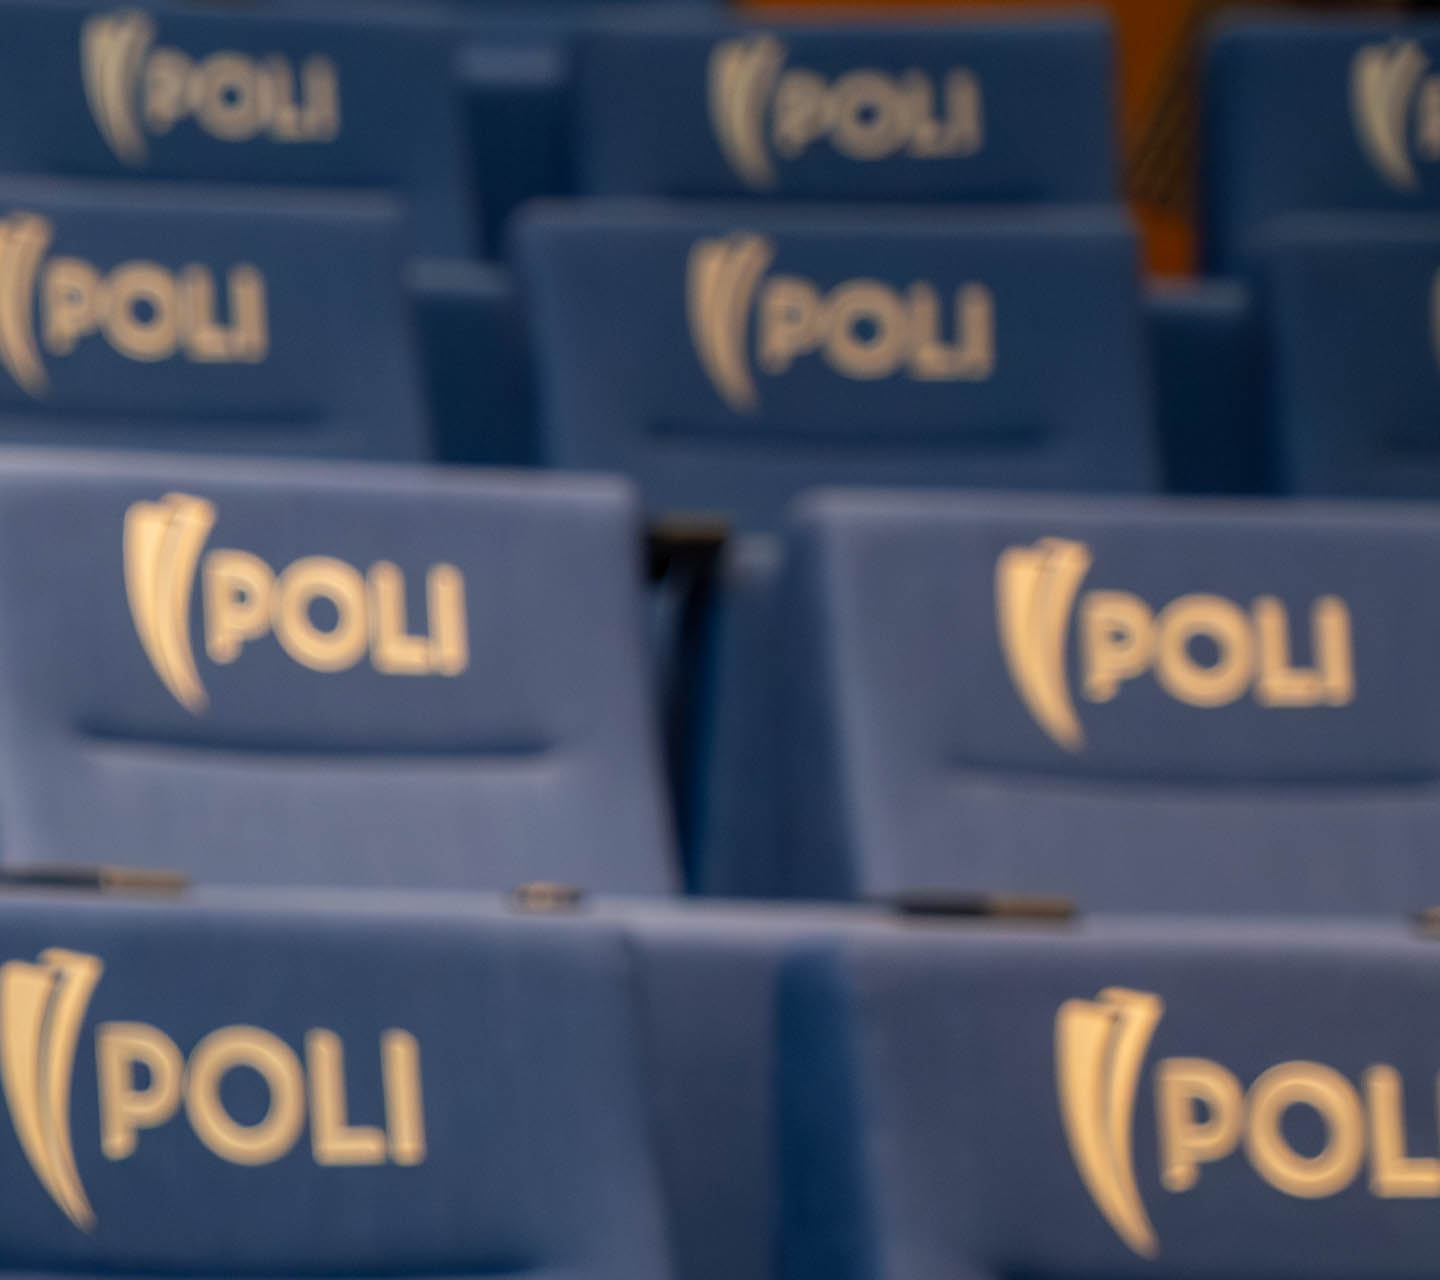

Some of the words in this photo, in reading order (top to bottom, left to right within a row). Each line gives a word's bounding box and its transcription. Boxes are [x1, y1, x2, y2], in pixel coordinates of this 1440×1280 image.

[147, 48, 339, 142] POLI
[772, 64, 982, 158] POLI
[43, 256, 268, 363] POLI
[757, 277, 995, 380] POLI
[204, 549, 469, 676] POLI
[1081, 591, 1355, 707] POLI
[97, 1021, 427, 1166] POLI
[1157, 1056, 1440, 1199] POL
